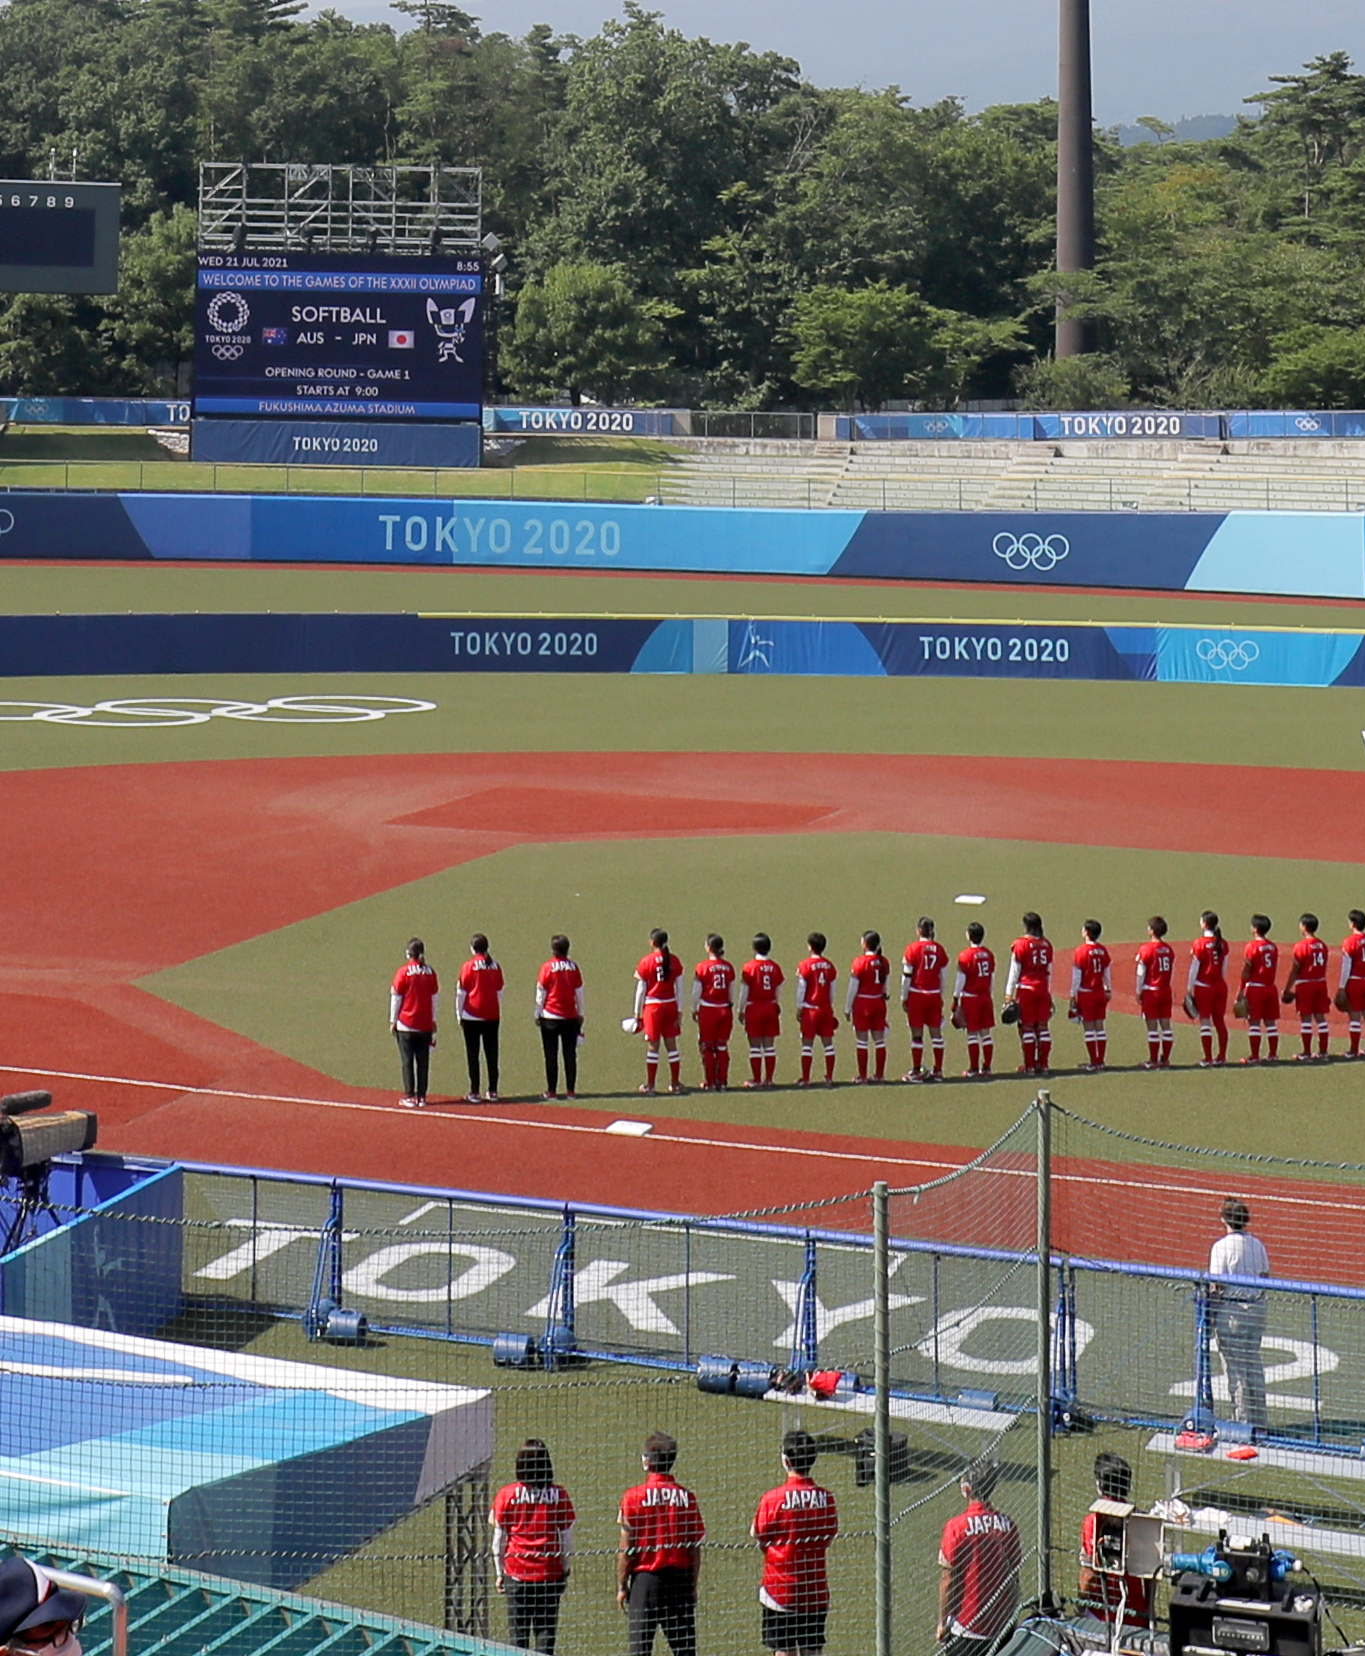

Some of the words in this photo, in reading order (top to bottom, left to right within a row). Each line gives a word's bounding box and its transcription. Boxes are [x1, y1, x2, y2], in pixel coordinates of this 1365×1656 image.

[11, 195, 20, 206] 6
[29, 196, 38, 207] 7
[46, 196, 56, 208] 8
[64, 196, 74, 208] 9
[198, 257, 223, 266] WED
[226, 257, 238, 267] 21
[241, 257, 260, 267] JUL
[262, 258, 288, 268] 2021
[456, 261, 480, 271] 8:55
[203, 274, 262, 287] WELCOME
[264, 275, 279, 287] TO
[282, 275, 302, 287] THE
[305, 276, 346, 288] GAMES
[350, 277, 363, 289] OF
[367, 277, 387, 290] THE
[389, 278, 417, 290] XXXII
[419, 278, 476, 290] OLYMPIAD
[291, 306, 387, 324] SOFTBALL
[205, 335, 230, 344] TOKYO
[232, 335, 251, 344] 2020
[296, 332, 324, 344] AUS
[352, 333, 377, 345] JPN
[265, 367, 315, 378] OPENING
[318, 368, 357, 379] ROUND
[367, 369, 401, 380] GAME
[403, 369, 410, 380] 1
[296, 385, 335, 396] STARTS
[336, 386, 350, 396] AT
[355, 386, 379, 397] 9:00
[258, 402, 323, 413] FUKUSHIMA
[325, 403, 365, 414] AZUMA
[367, 404, 415, 415] STADIUM
[519, 411, 582, 430] TOKYO
[586, 412, 634, 432] 2020
[1060, 416, 1127, 436] TOKYO
[1130, 416, 1180, 436] 2020
[293, 436, 340, 452] TOKYO
[343, 437, 378, 452] 2020
[378, 514, 512, 554] TOKYO
[523, 518, 620, 556] 2020
[450, 632, 532, 656] TOKYO
[538, 633, 598, 656] 2020
[919, 636, 1002, 660] TOKYO
[1008, 638, 1070, 662] 2020
[472, 959, 498, 970] JAAN
[550, 960, 576, 972] JAPAN
[924, 954, 936, 970] 17
[1264, 952, 1272, 968] 5
[1313, 952, 1324, 966] 14
[406, 964, 432, 976] JAPAN
[978, 960, 989, 976] 12
[714, 973, 726, 988] 21
[818, 972, 826, 986] 4
[193, 1219, 1096, 1375] TOKYO
[510, 1487, 559, 1505] JAPAN
[642, 1488, 689, 1509] JAPAN
[781, 1490, 828, 1510] JAPAN
[965, 1515, 1010, 1536] JAPAN
